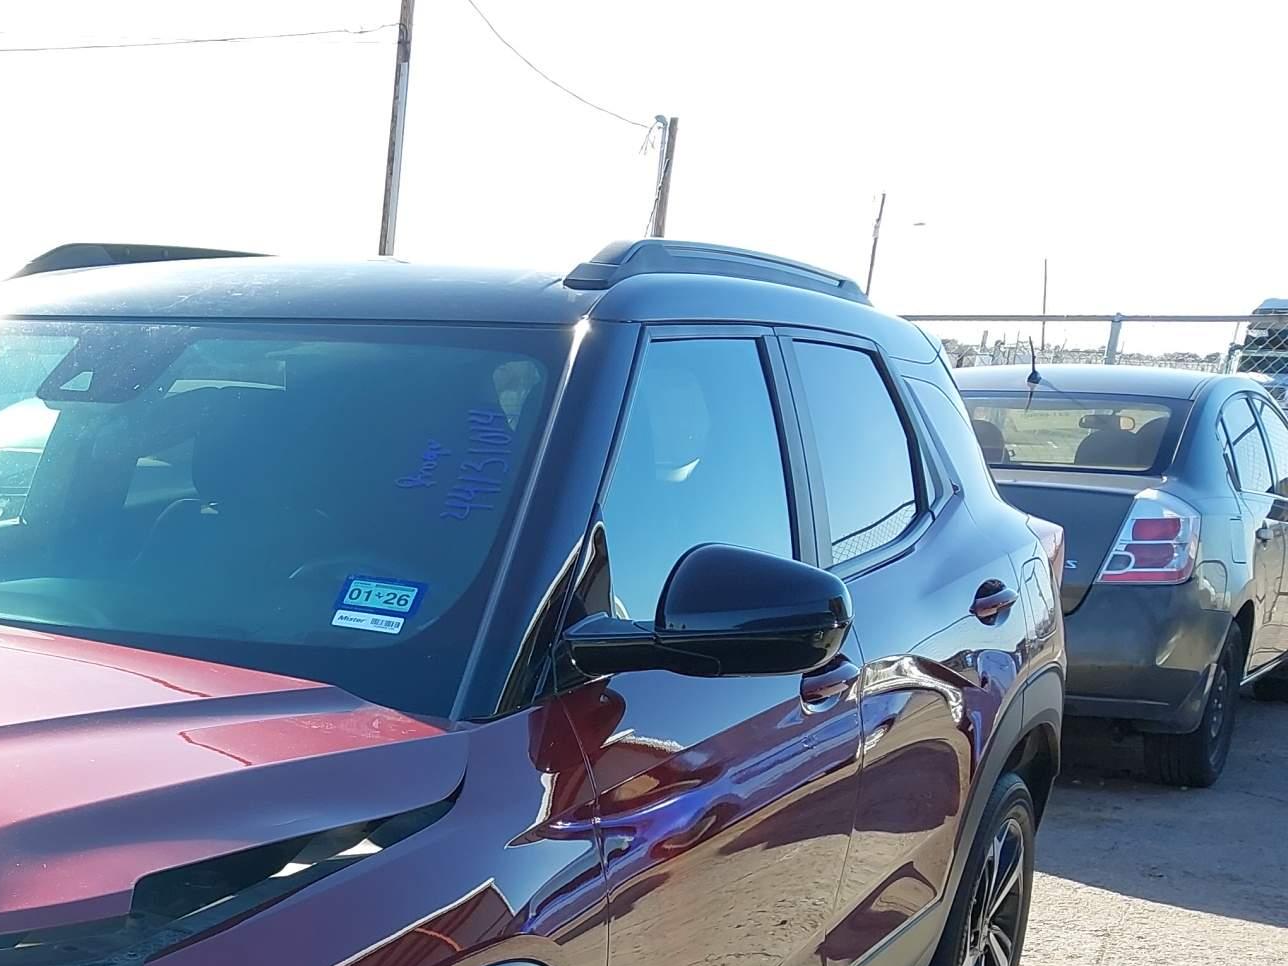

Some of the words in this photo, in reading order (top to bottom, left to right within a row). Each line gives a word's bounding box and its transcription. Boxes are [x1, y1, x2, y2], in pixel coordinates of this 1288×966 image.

[438, 408, 513, 520] 44131014
[348, 587, 373, 602] 01
[382, 591, 411, 607] 26
